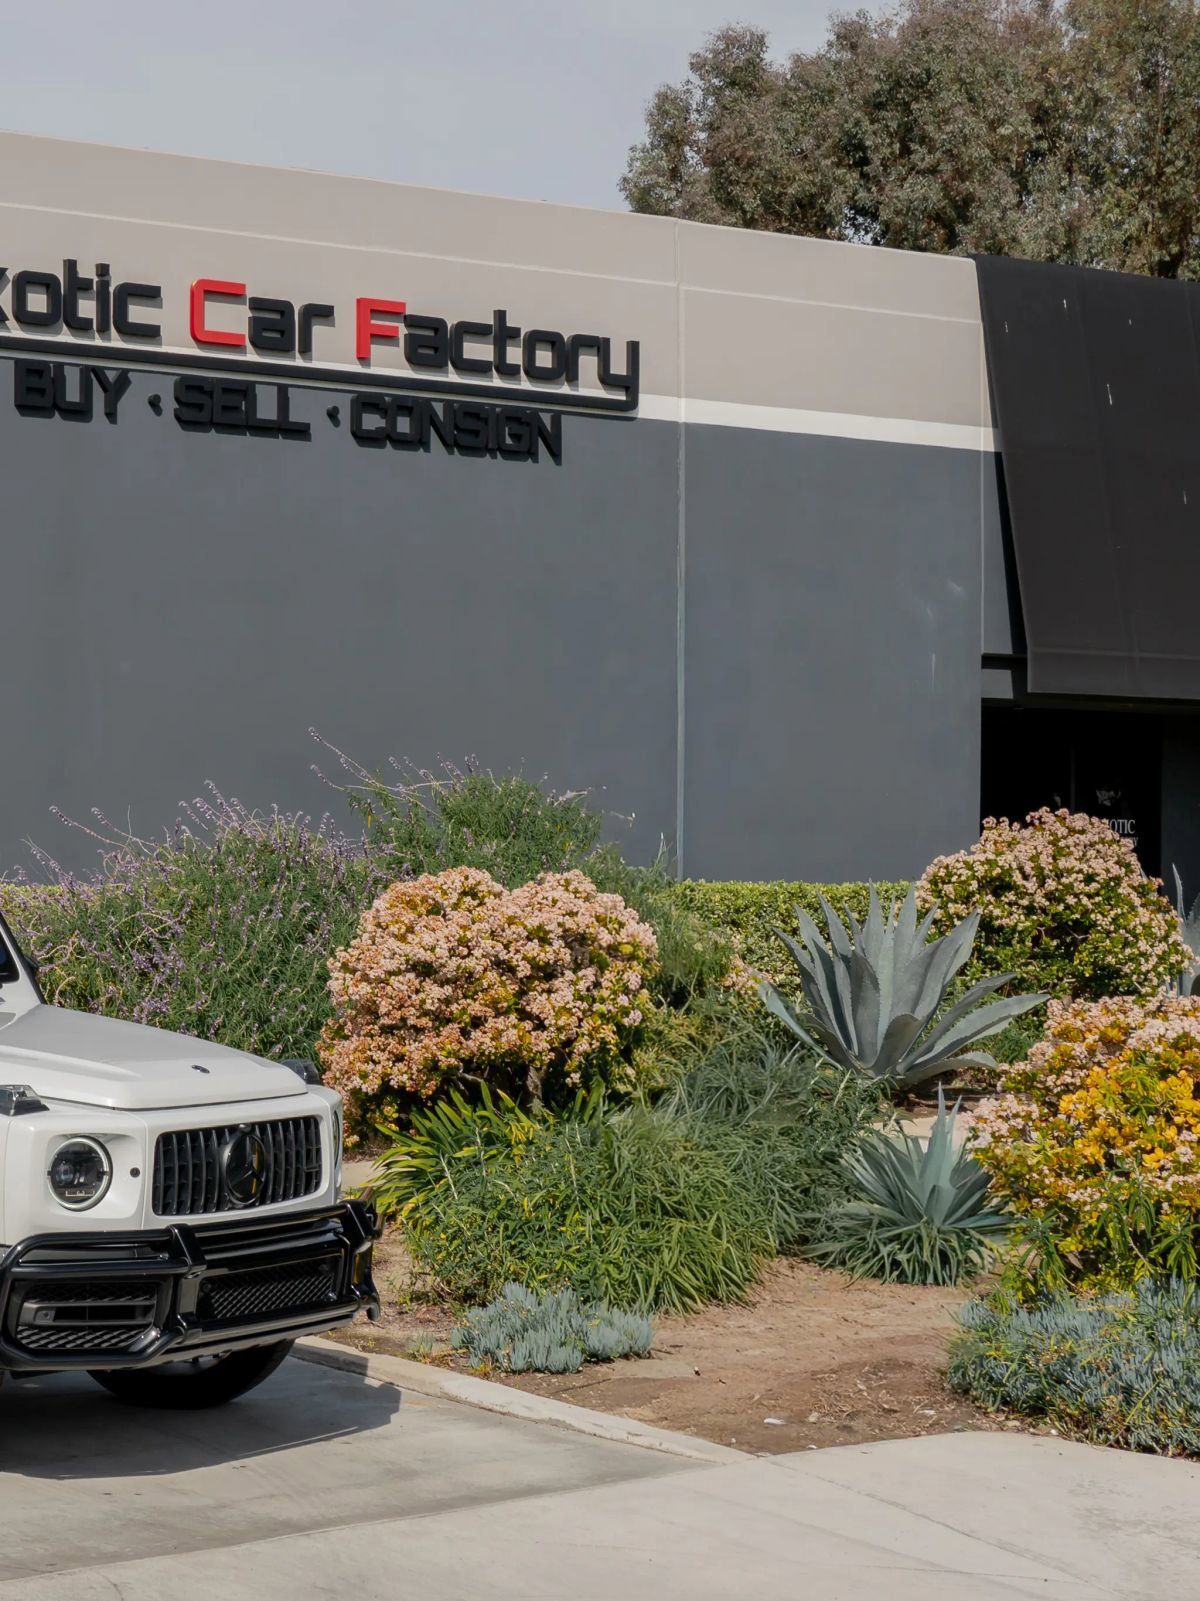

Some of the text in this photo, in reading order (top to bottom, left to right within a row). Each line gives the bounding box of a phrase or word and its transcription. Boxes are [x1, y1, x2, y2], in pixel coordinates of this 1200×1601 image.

[190, 279, 334, 354] Car
[356, 297, 639, 407] Factory
[14, 359, 562, 463] BUY SELL CONSIGN
[1109, 818, 1136, 834] OTIC
